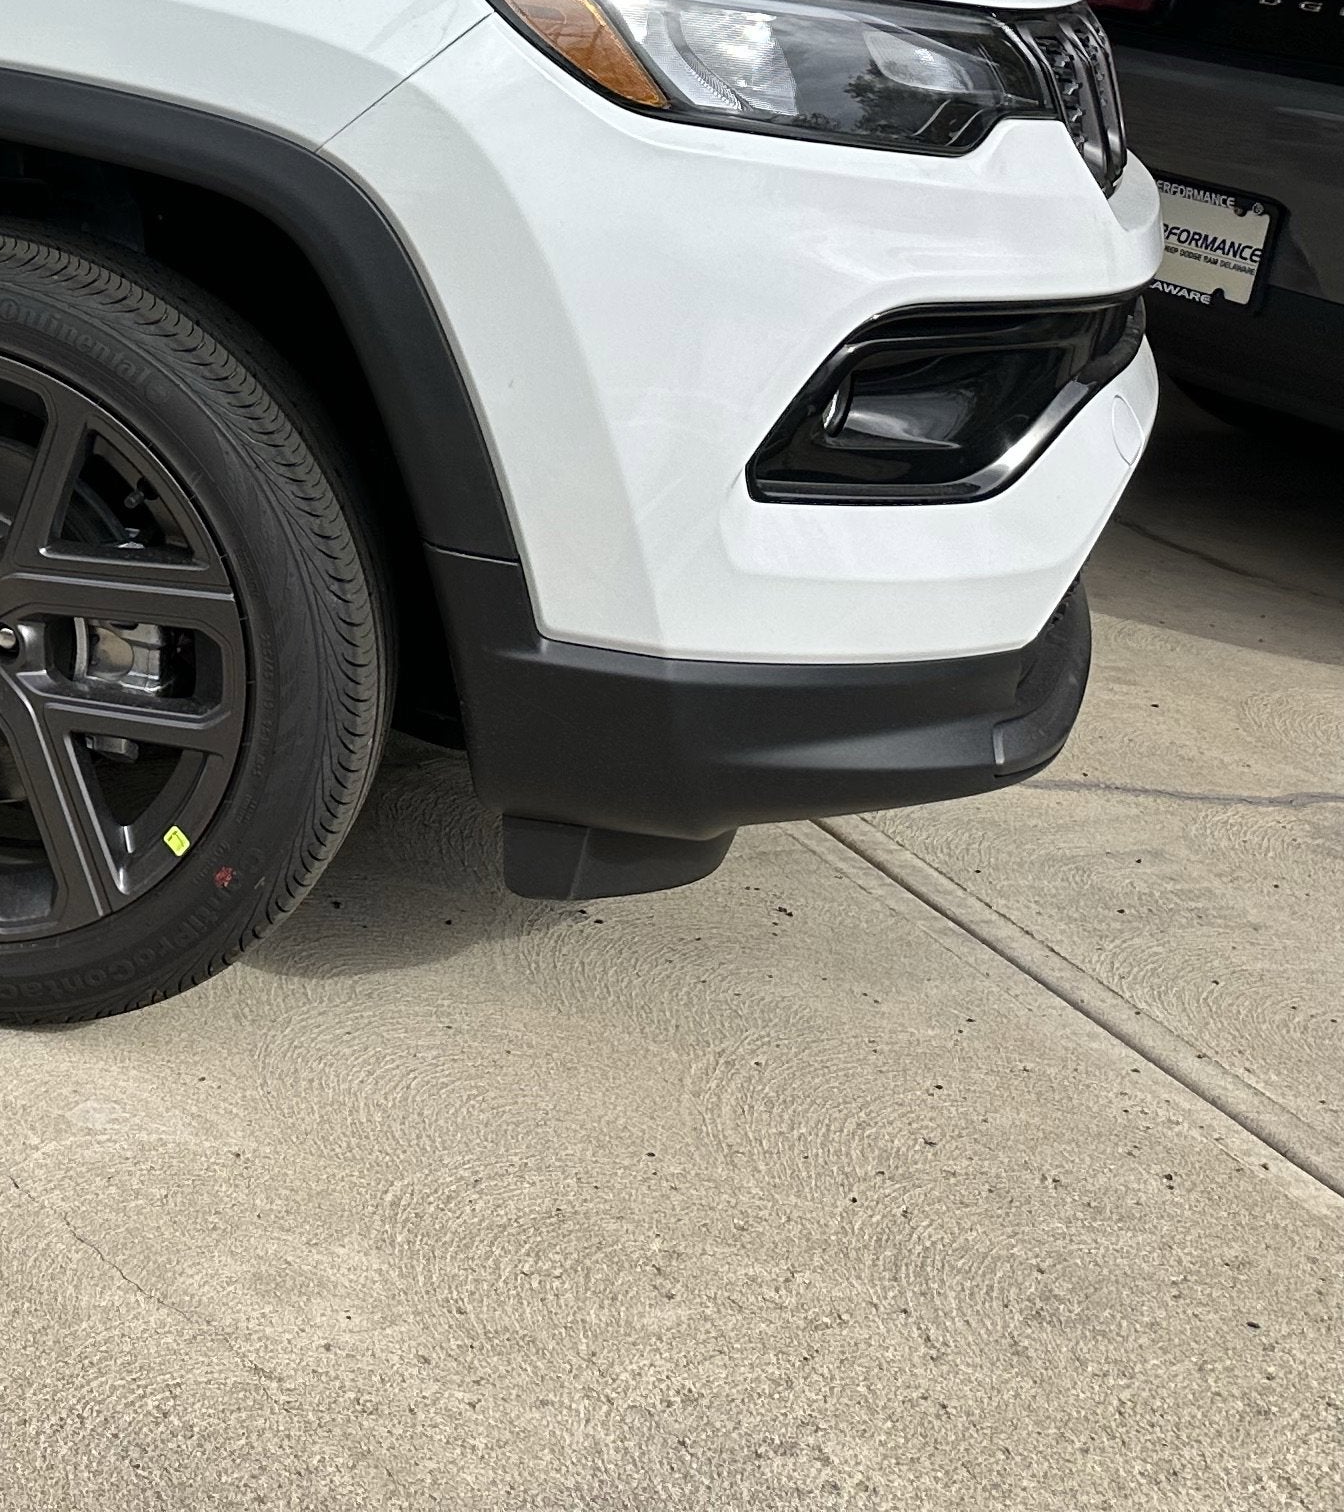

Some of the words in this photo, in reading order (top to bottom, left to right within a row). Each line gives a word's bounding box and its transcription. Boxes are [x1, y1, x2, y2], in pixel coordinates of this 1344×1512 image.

[1156, 179, 1236, 209] ERFORMANCE
[1163, 222, 1264, 264] FORMANCE
[1149, 280, 1212, 305] AWARE
